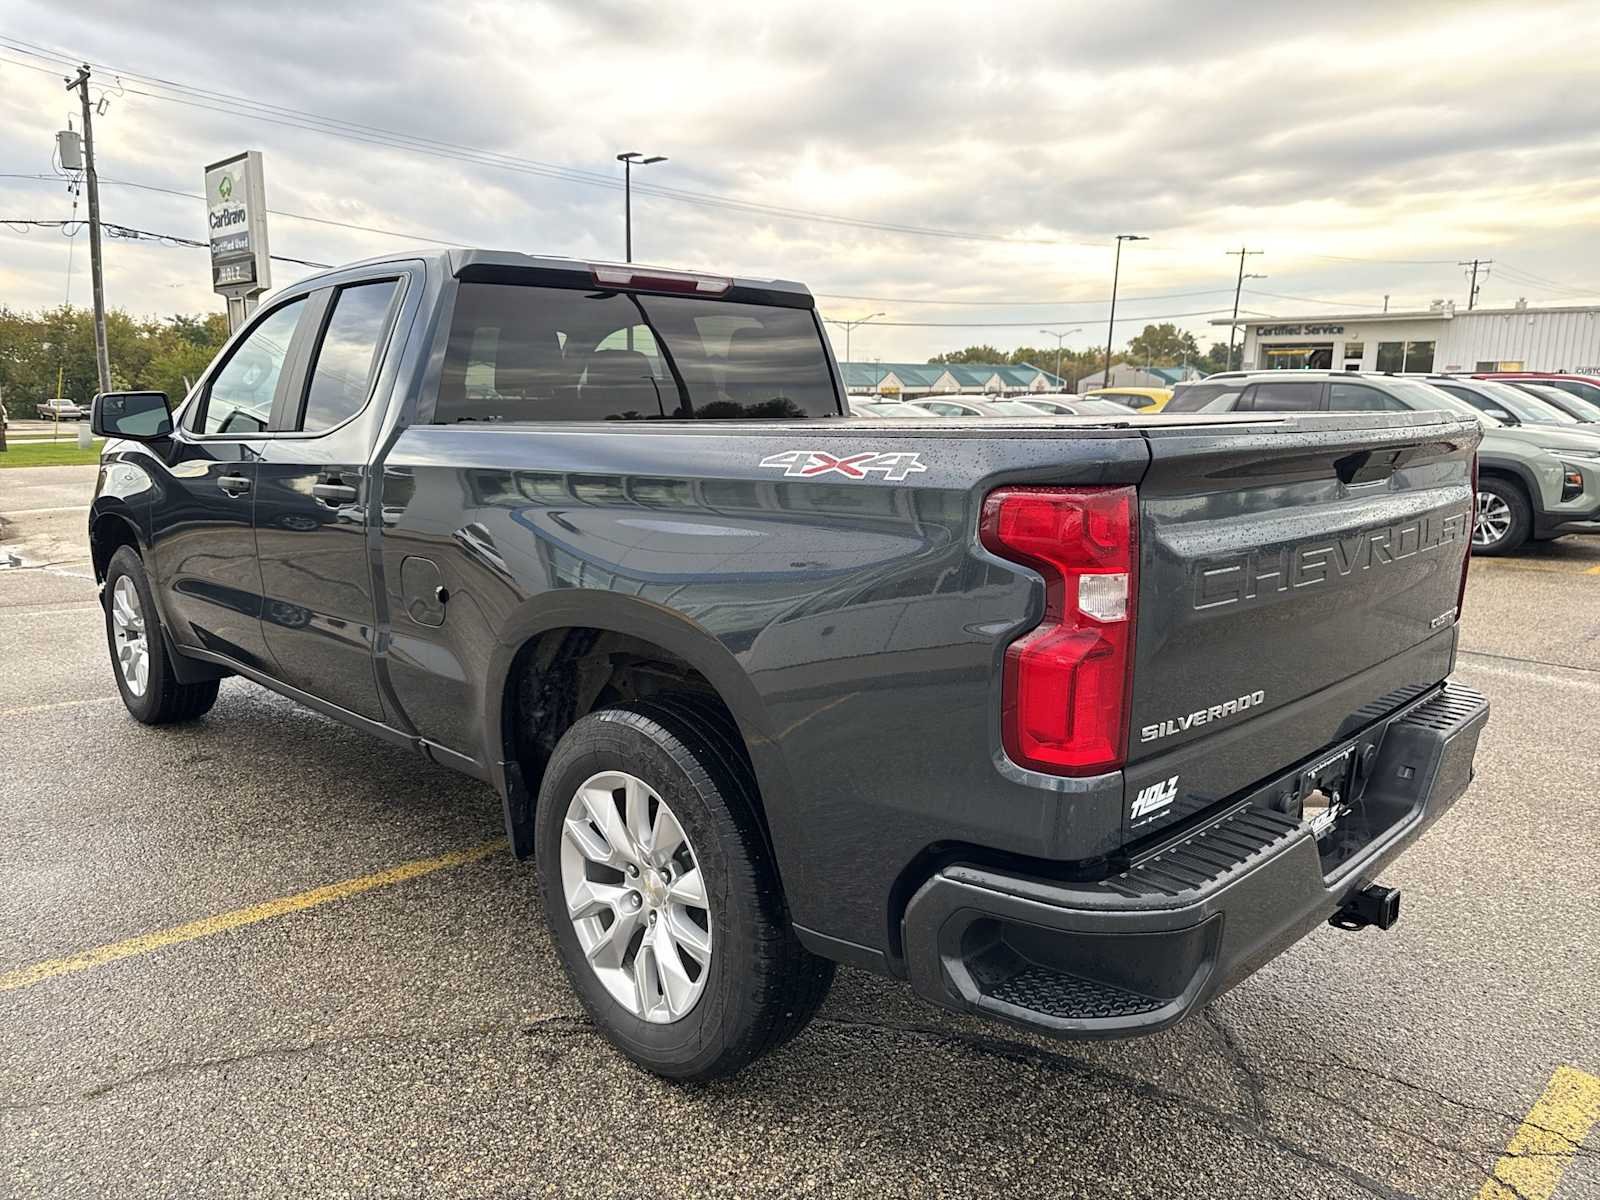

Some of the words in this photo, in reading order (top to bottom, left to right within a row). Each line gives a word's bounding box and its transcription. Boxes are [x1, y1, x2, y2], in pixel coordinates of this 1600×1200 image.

[210, 208, 246, 229] CarBravo
[211, 238, 234, 255] Certified
[235, 236, 248, 250] Used
[220, 264, 241, 281] HOLZ
[1256, 325, 1302, 337] Certified
[1303, 324, 1345, 336] Service
[1141, 690, 1265, 742] SILVERADO
[1131, 775, 1179, 820] HOLZ
